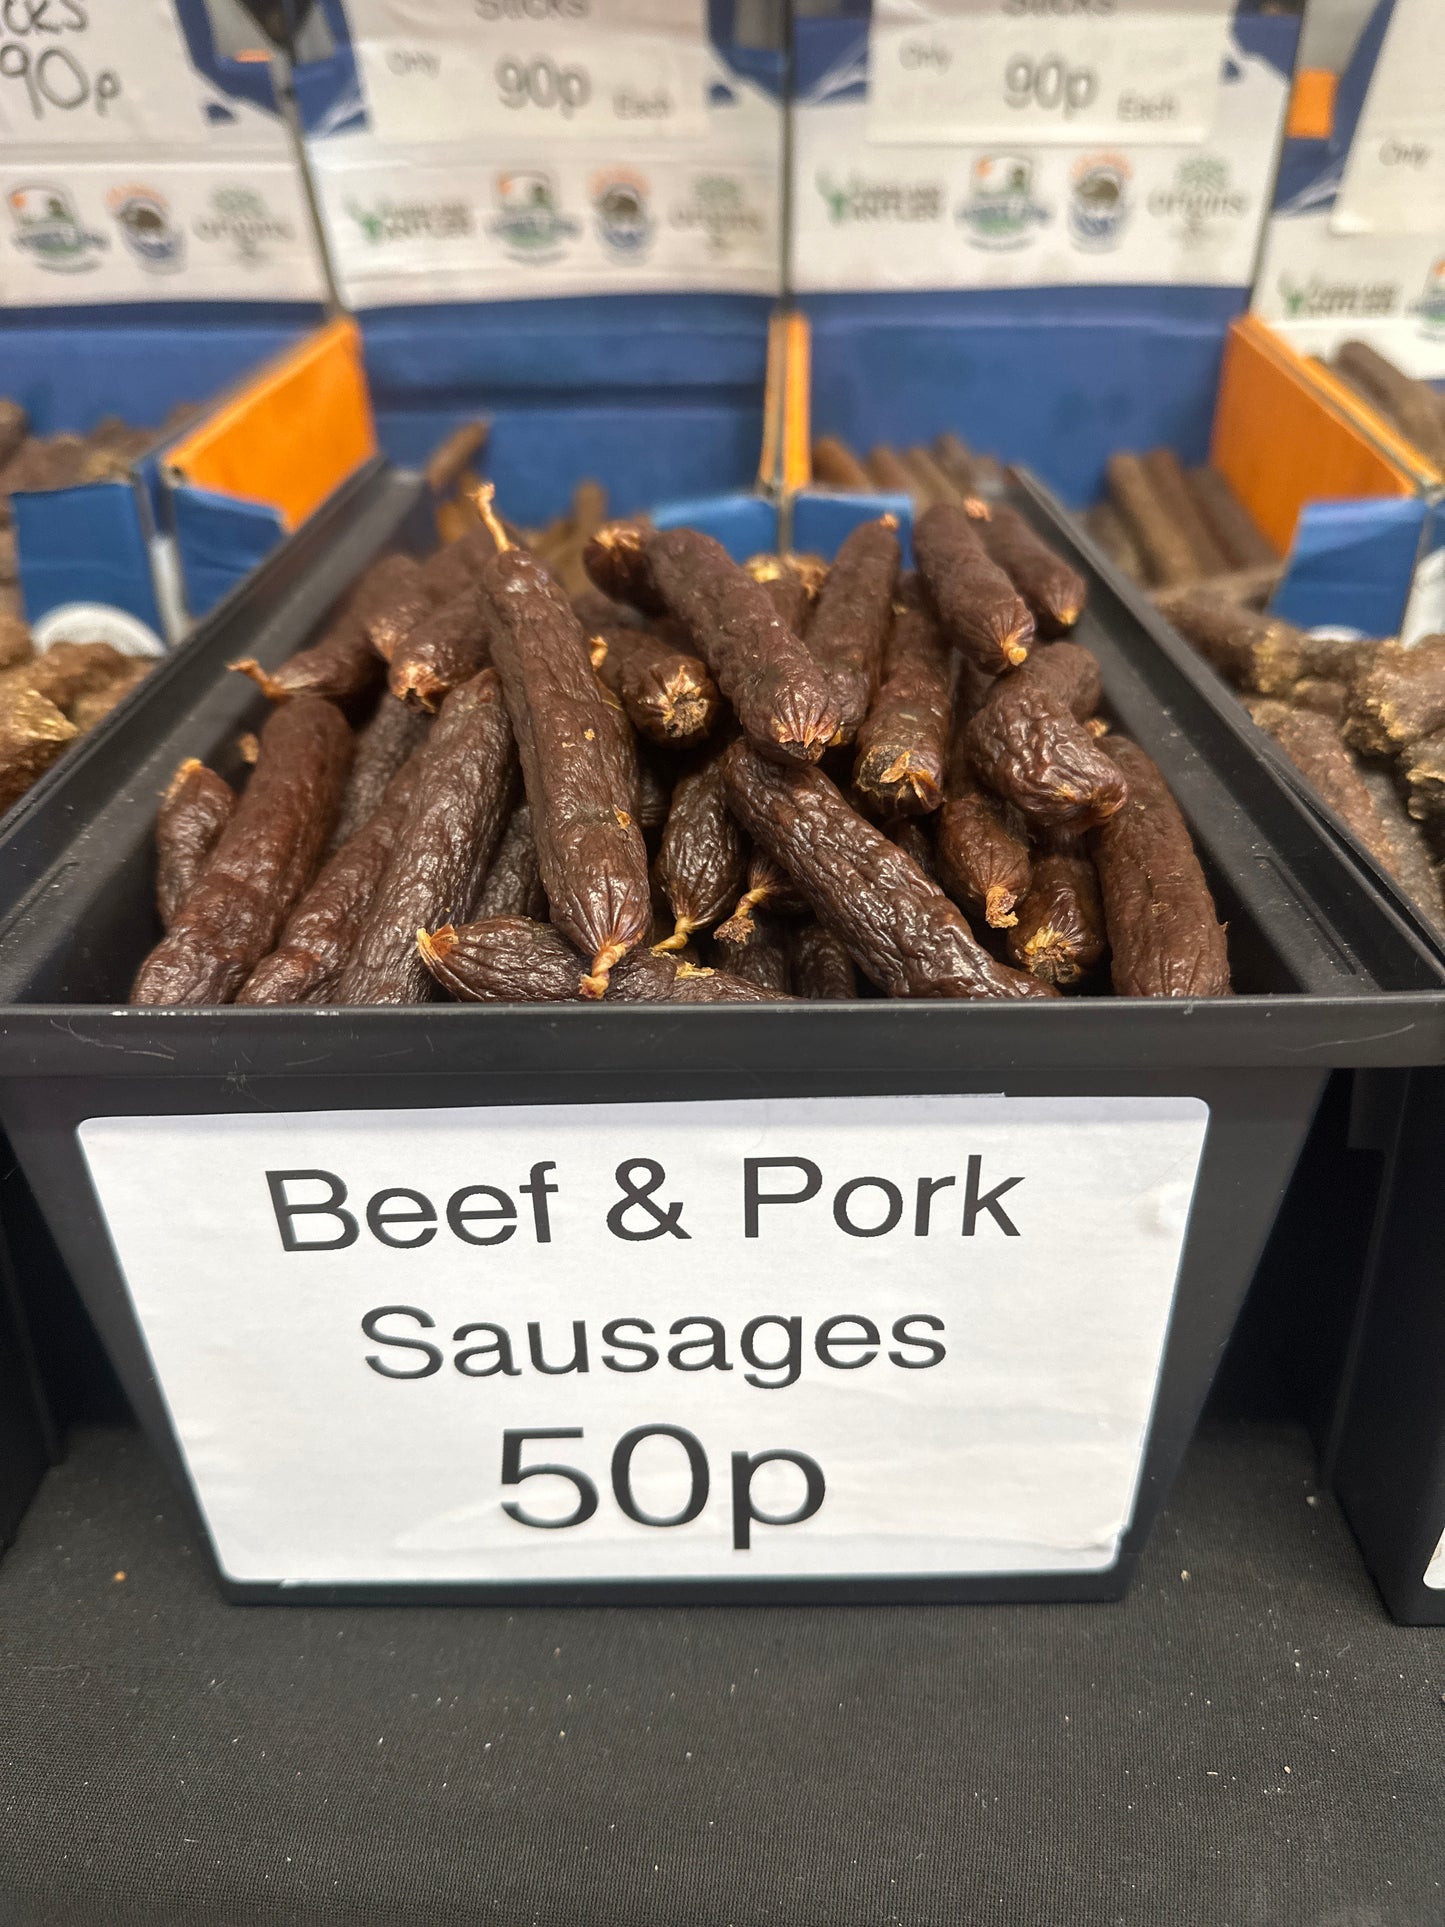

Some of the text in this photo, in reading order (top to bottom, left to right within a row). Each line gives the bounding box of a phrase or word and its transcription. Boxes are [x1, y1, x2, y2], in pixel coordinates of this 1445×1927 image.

[0, 45, 122, 119] 90p
[496, 55, 591, 120] 90p
[1004, 53, 1099, 121] 90p
[265, 1154, 1025, 1252] Beef & Pork
[361, 1306, 946, 1390] Sausages
[500, 1425, 826, 1550] 50p
